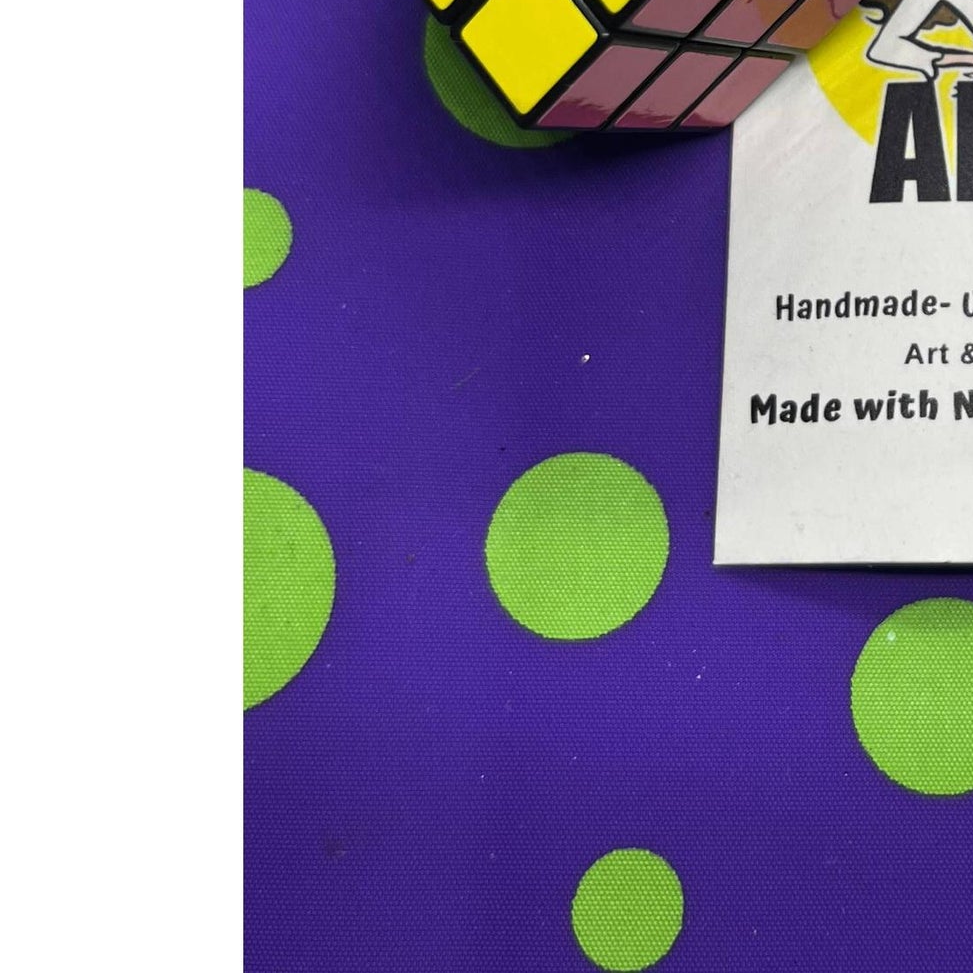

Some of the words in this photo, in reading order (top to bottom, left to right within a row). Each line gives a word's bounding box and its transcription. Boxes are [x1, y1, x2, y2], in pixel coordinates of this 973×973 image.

[775, 289, 951, 322] Handmade-
[904, 343, 949, 365] Art
[750, 393, 842, 426] Made
[853, 389, 939, 422] with
